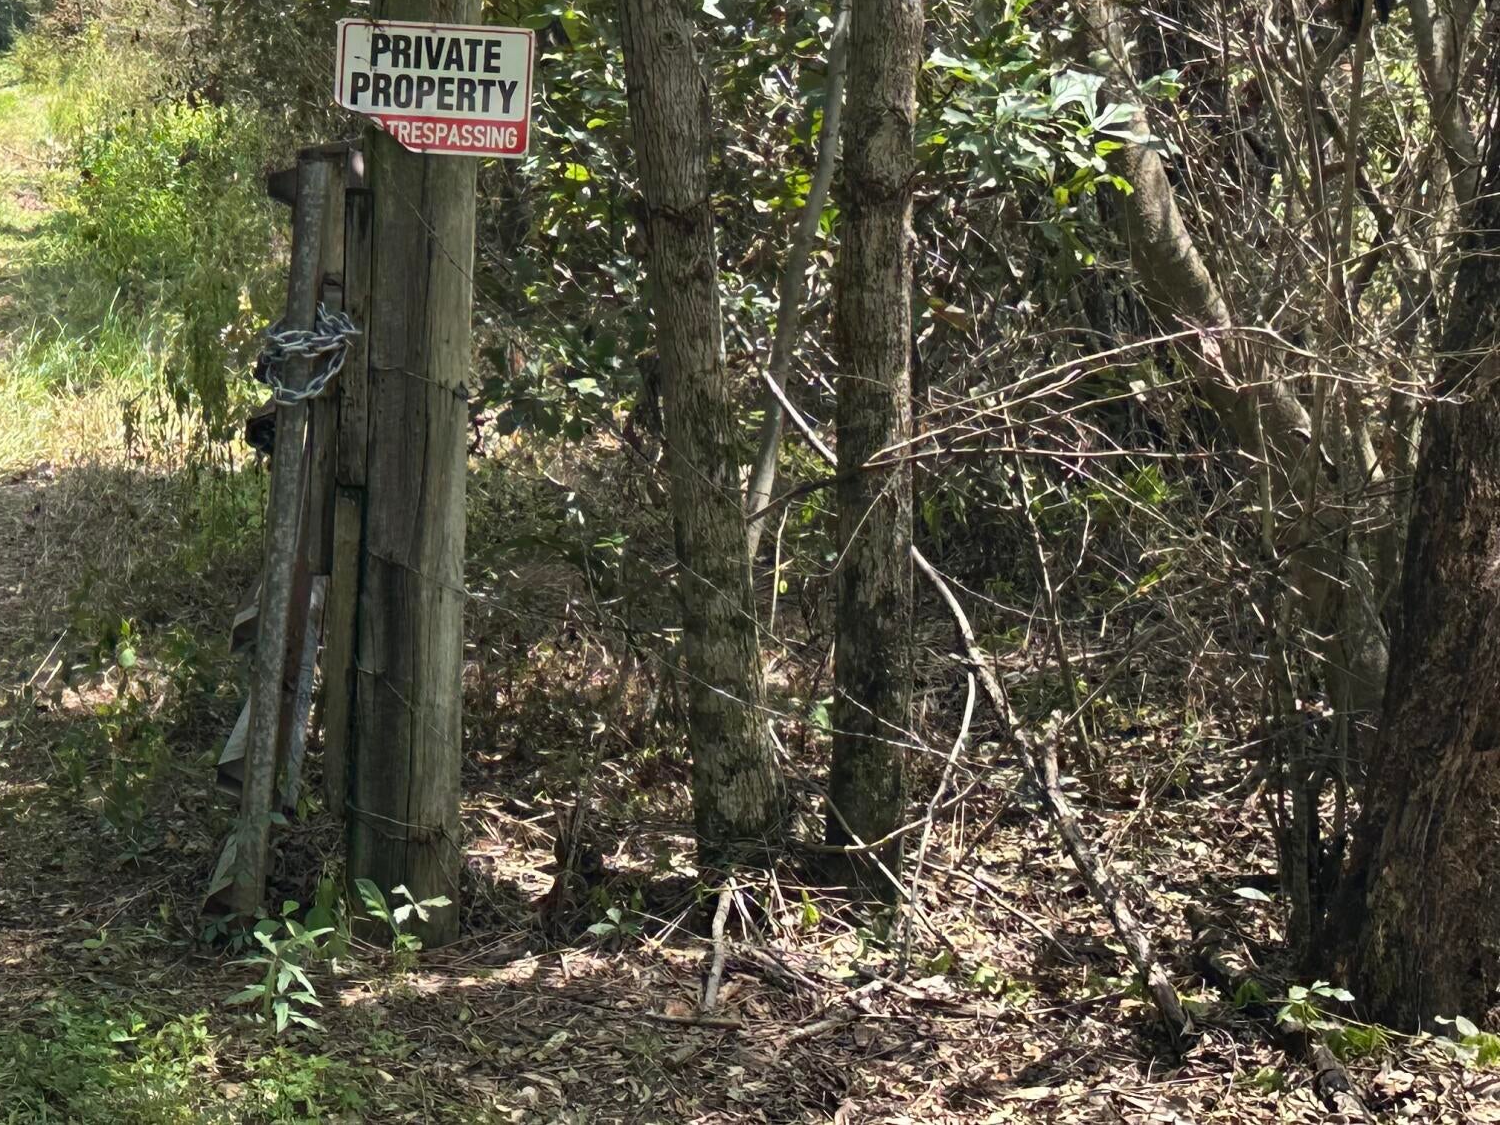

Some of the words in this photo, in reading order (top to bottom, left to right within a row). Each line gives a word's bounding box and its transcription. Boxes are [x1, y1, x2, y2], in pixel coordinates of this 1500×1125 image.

[370, 33, 502, 73] PRIVATE
[350, 72, 518, 114] PROPERTY
[386, 120, 518, 149] TRESPASSING
